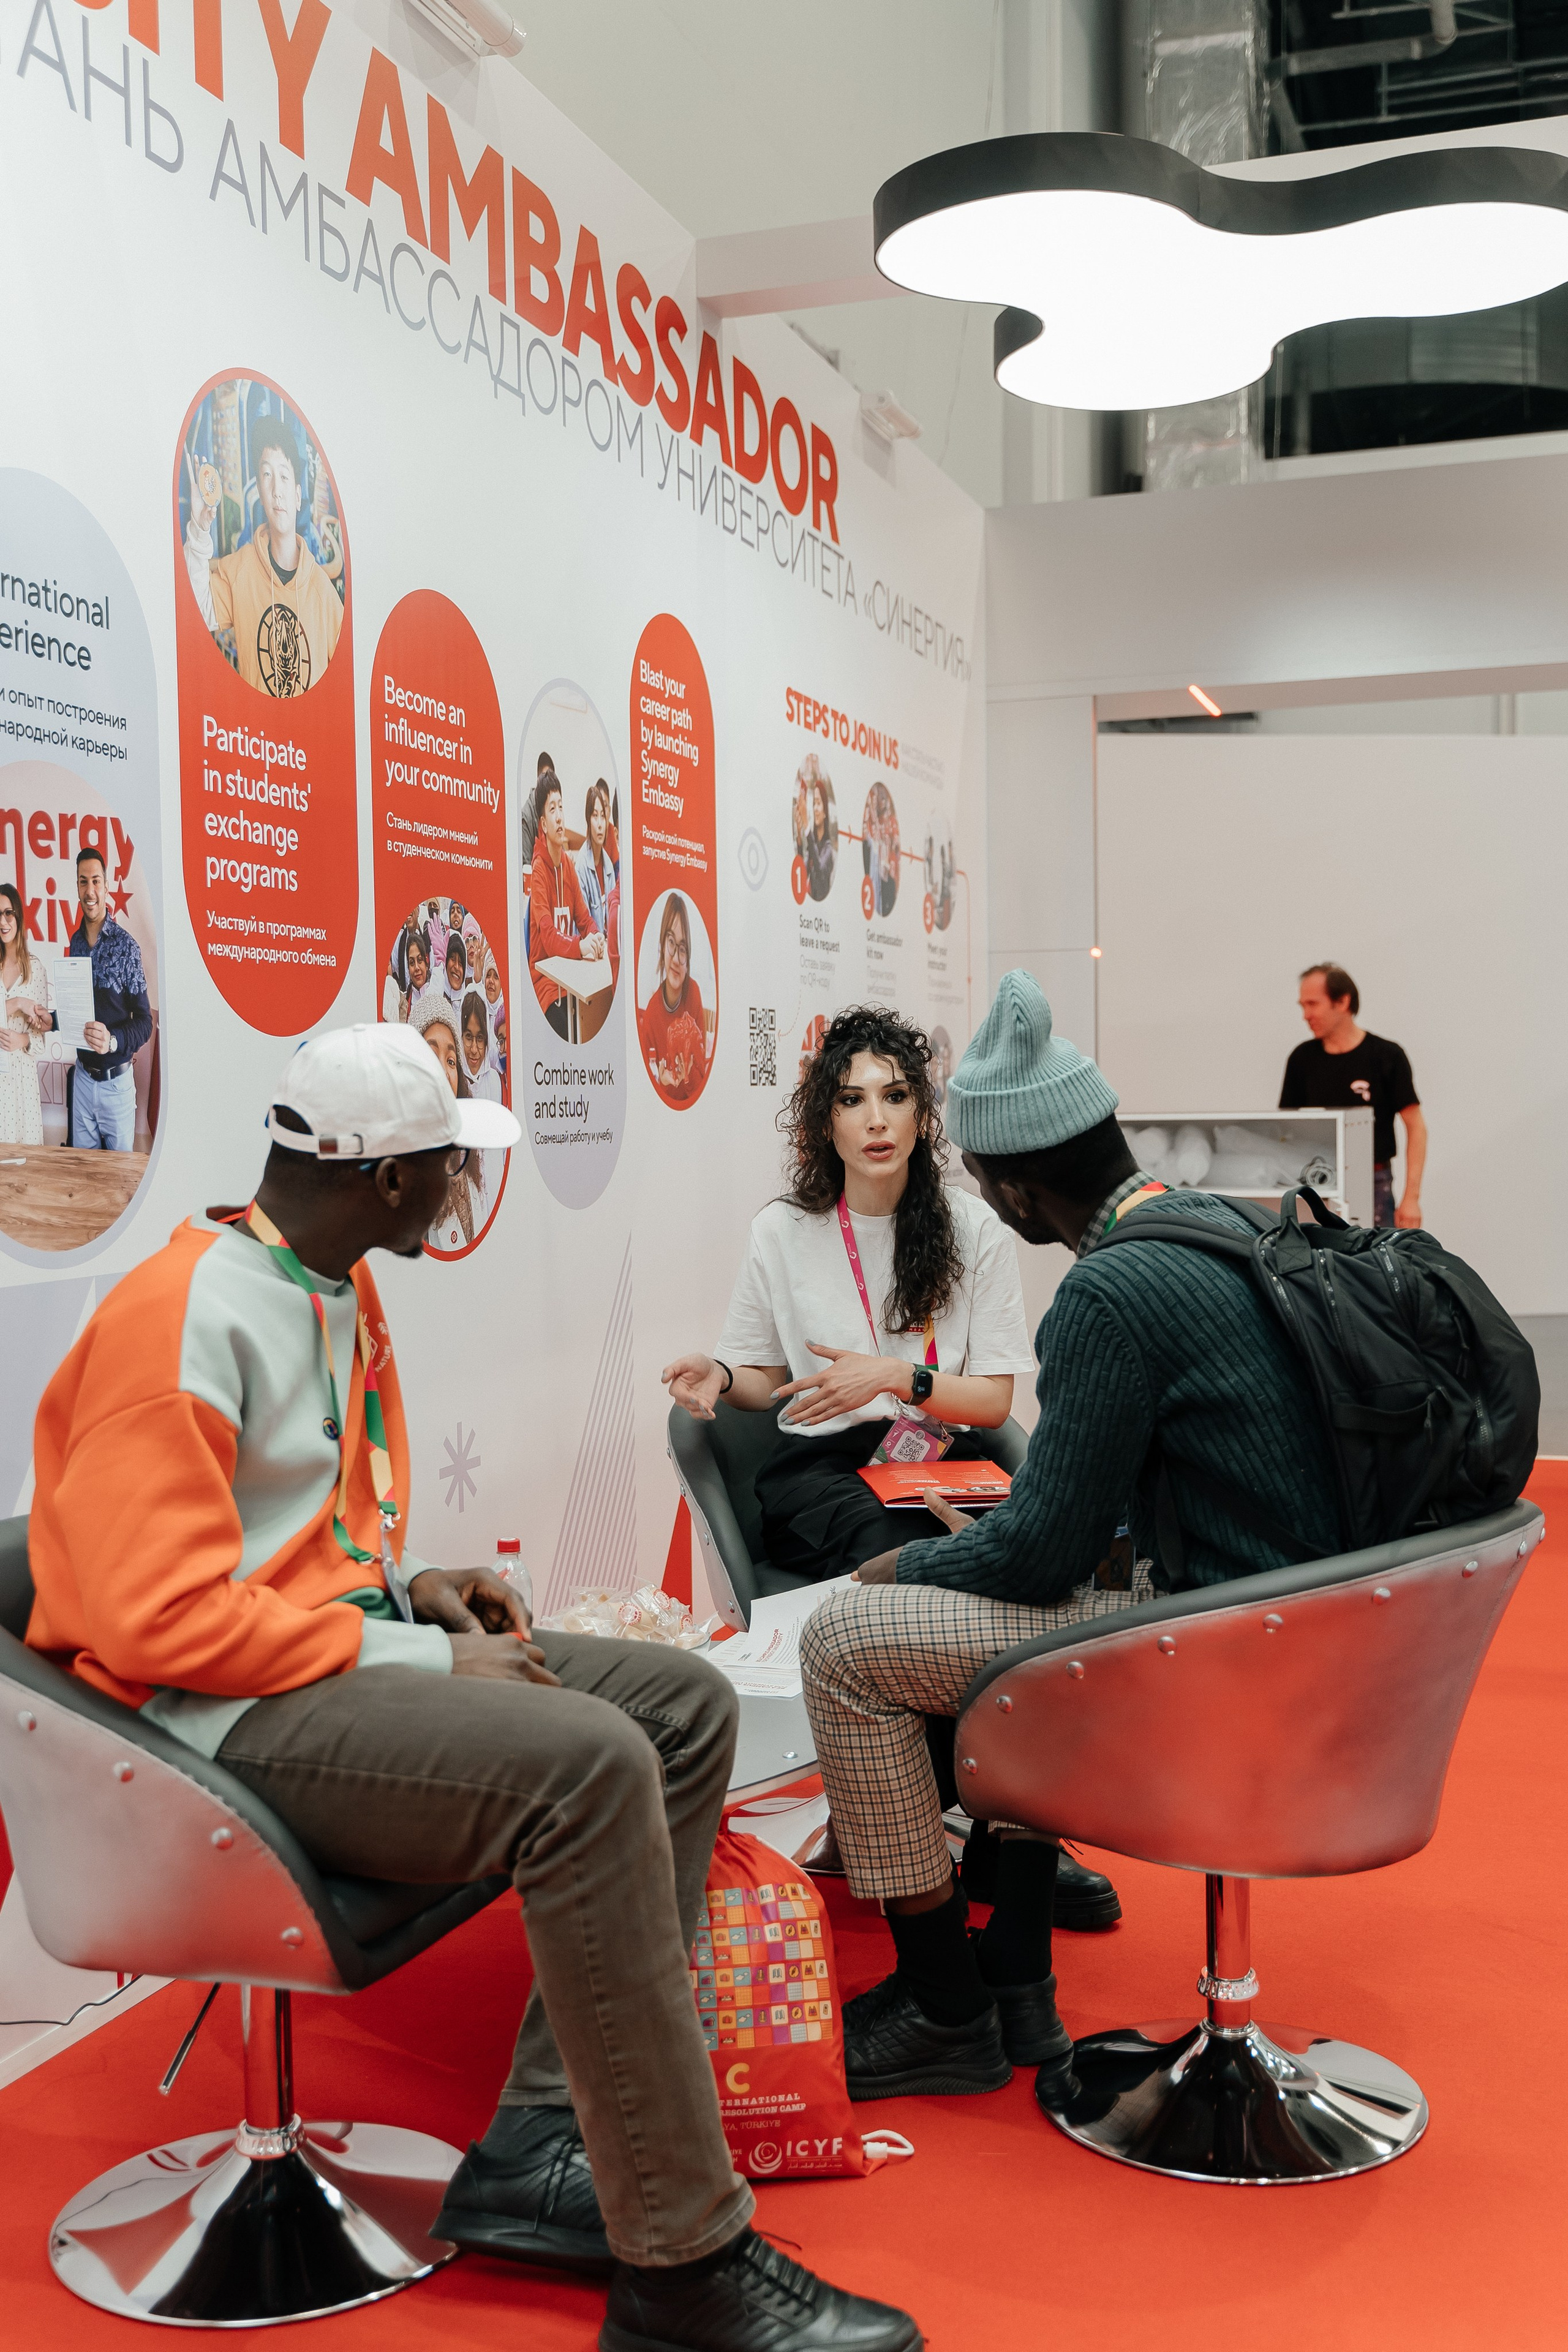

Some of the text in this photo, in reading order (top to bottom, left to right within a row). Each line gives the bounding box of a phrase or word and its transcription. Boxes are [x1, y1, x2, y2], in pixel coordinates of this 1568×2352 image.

[345, 46, 840, 545] AMBASSADOR
[209, 118, 644, 477] АМБАССАДОРОМ
[656, 422, 858, 616] УНИВЕРСИТЕТА
[864, 580, 971, 681] «СИНЕРГИЯ»
[0, 619, 92, 671] erience
[639, 659, 686, 699] Blast your
[9, 689, 45, 710] опыт
[48, 699, 127, 731] построения
[384, 674, 466, 728] Become an
[640, 695, 693, 731] career path
[203, 714, 307, 771] Participate
[385, 713, 472, 766] influencer in
[641, 718, 699, 767] by launching
[786, 686, 830, 739] STEPS
[831, 708, 850, 747] TO
[851, 719, 881, 763] JOIN
[883, 734, 900, 771] US
[71, 735, 128, 762] карьеры
[203, 760, 311, 812] in students'
[641, 749, 680, 789] Synergy
[385, 759, 500, 814] your community
[642, 778, 684, 819] Embassy
[205, 810, 299, 857] exchange
[386, 812, 479, 846] Стань лидером мнений
[642, 824, 706, 855] Раскрой свой потенциал,
[387, 840, 493, 871] в студенческом комьюнити
[642, 845, 708, 873] запустив Synergy Embassy
[206, 856, 298, 893] programs
[796, 865, 801, 894] 1
[864, 884, 872, 911] 2
[926, 901, 932, 925] 3
[206, 910, 327, 941] Участвуй в программах
[799, 914, 830, 933] Scan QR to
[867, 928, 875, 941] Get
[208, 943, 337, 967] международного обмена
[799, 933, 840, 954] leave a request
[534, 1061, 614, 1085] Combine work
[534, 1094, 589, 1123] and study
[535, 1128, 613, 1146] Совмещай работу и учебу
[779, 2103, 806, 2112] CAMP
[786, 2137, 843, 2157] ICYF
